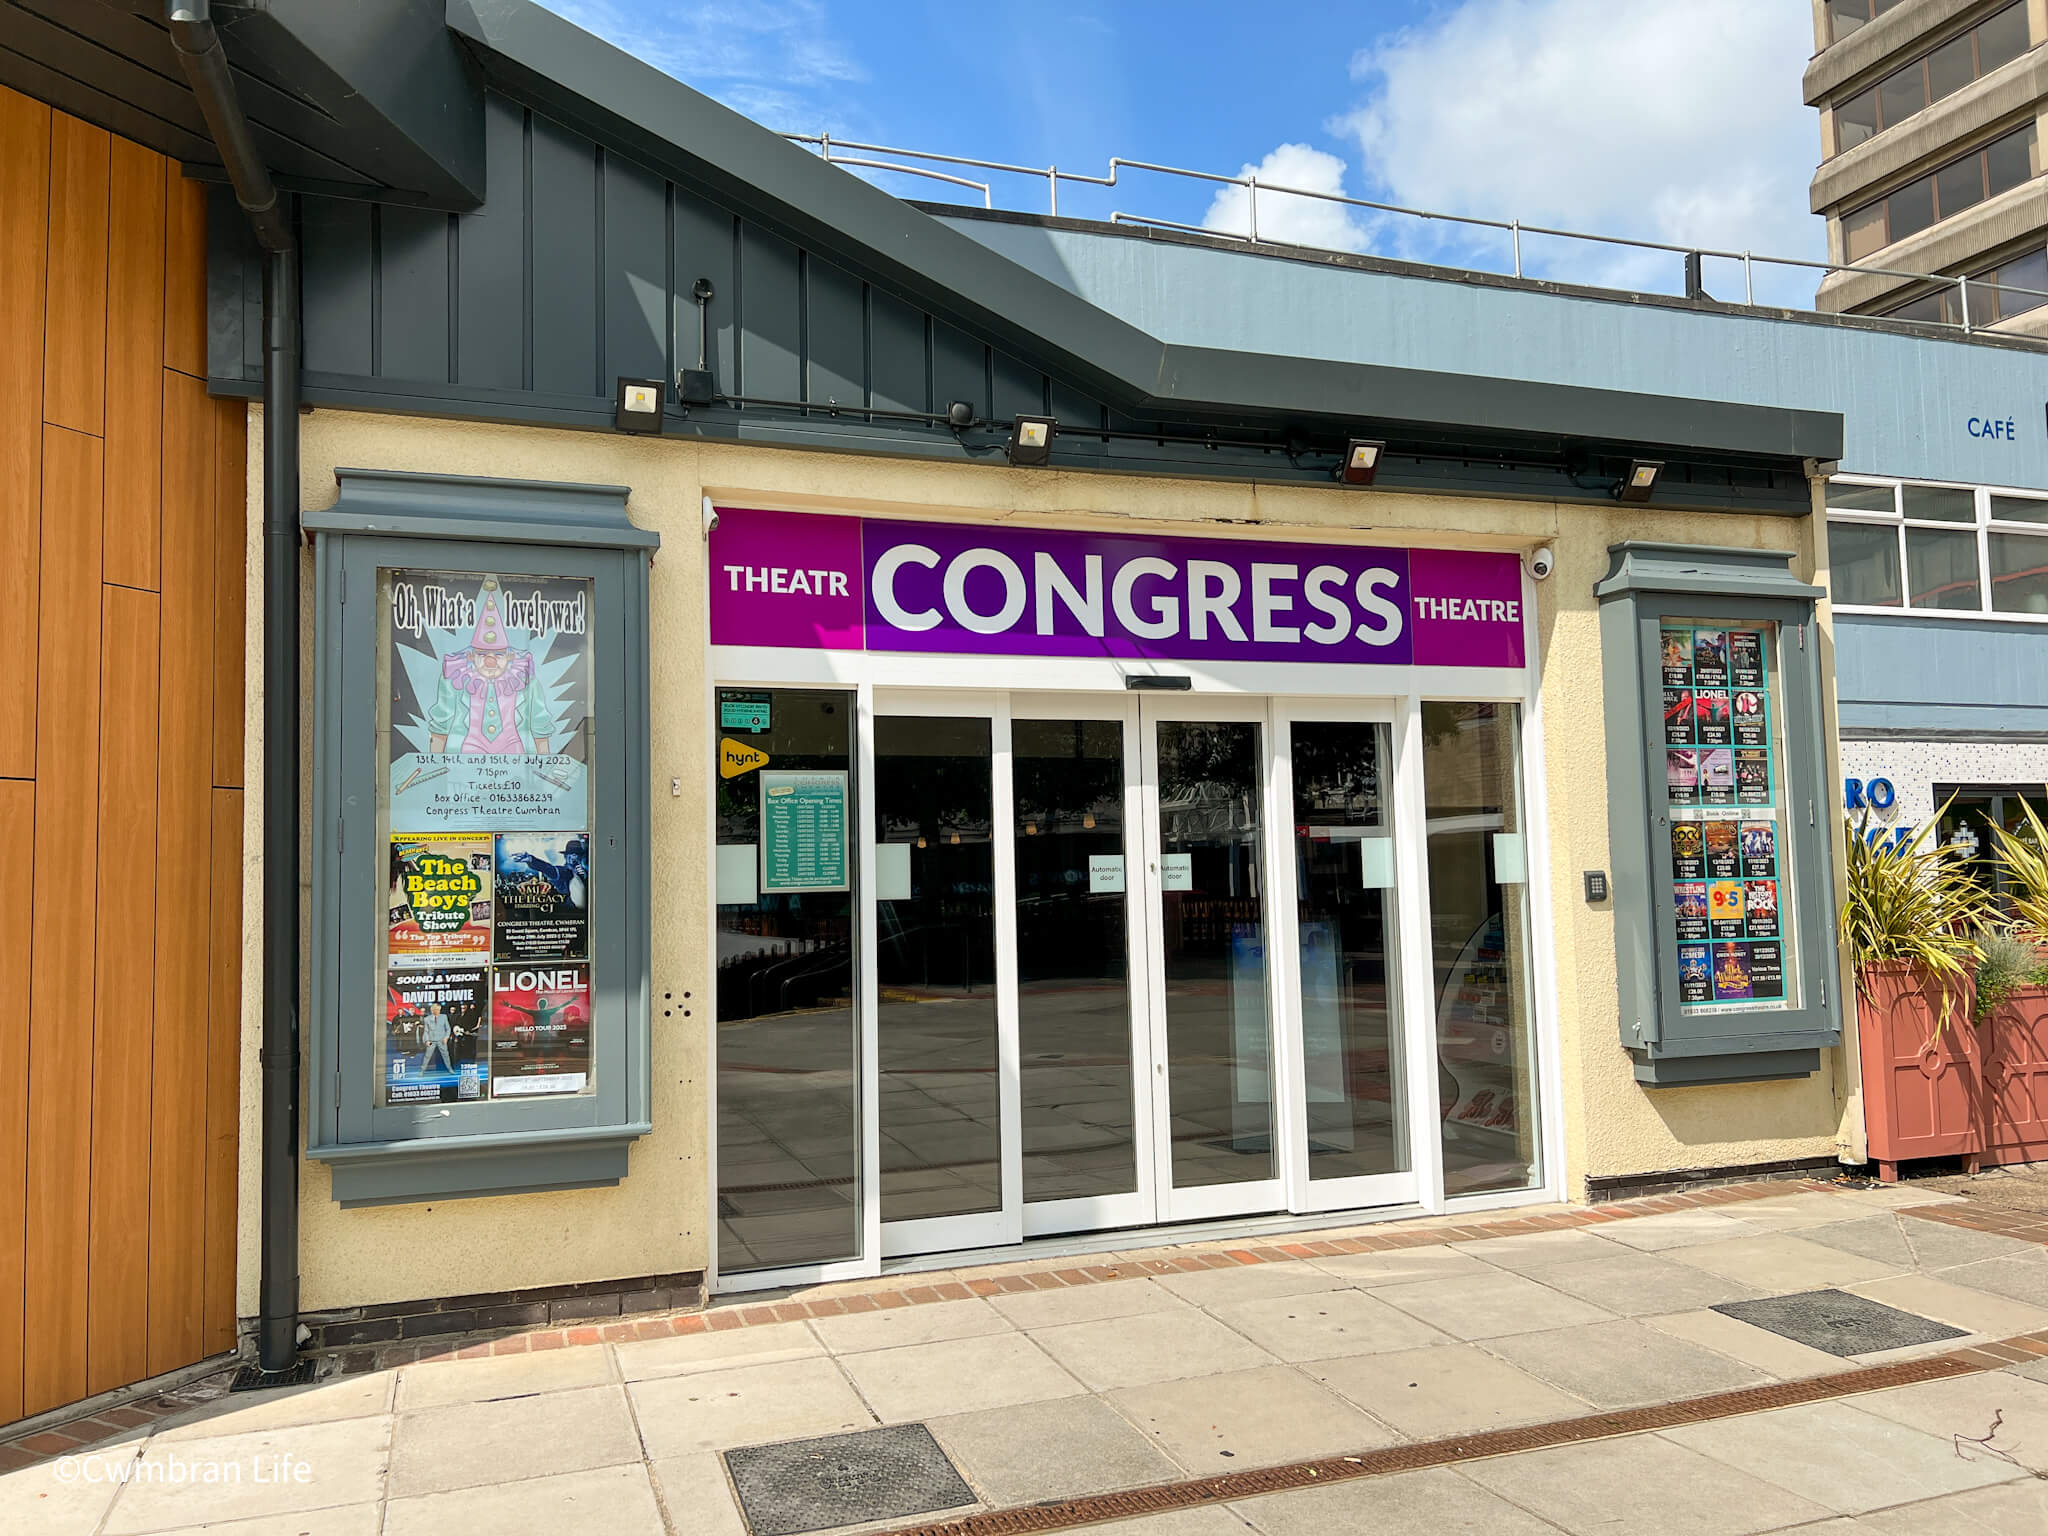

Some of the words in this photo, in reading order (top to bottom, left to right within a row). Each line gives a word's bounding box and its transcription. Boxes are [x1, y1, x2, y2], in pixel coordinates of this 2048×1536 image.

[1967, 416, 2015, 440] CAFÉ
[724, 565, 849, 597] THEATR
[871, 544, 1403, 647] CONGRESS
[394, 583, 422, 638] Oh,
[503, 591, 549, 638] lovely
[550, 591, 586, 634] war!
[1415, 597, 1519, 623] THEATRE
[1695, 690, 1728, 699] LIONEL
[467, 755, 486, 764] and
[490, 755, 509, 764] 15th
[525, 756, 543, 768] July
[546, 757, 570, 765] 2023
[726, 752, 760, 766] hynt
[454, 793, 480, 801] Office
[426, 807, 468, 820] Congress
[472, 806, 512, 815] Theatre
[515, 806, 561, 815] Cwmbran
[420, 860, 464, 875] The
[407, 875, 477, 891] Beach
[527, 895, 566, 903] LEGACY
[1747, 900, 1777, 911] ROCK
[417, 911, 465, 920] Tribute
[423, 921, 459, 929] Show
[396, 976, 433, 984] SOUND
[435, 975, 442, 983] &
[446, 973, 480, 982] VISION
[495, 970, 587, 992] LIONEL
[402, 991, 435, 1003] DAVID
[438, 989, 473, 1001] BOWIE
[393, 1064, 405, 1073] 01
